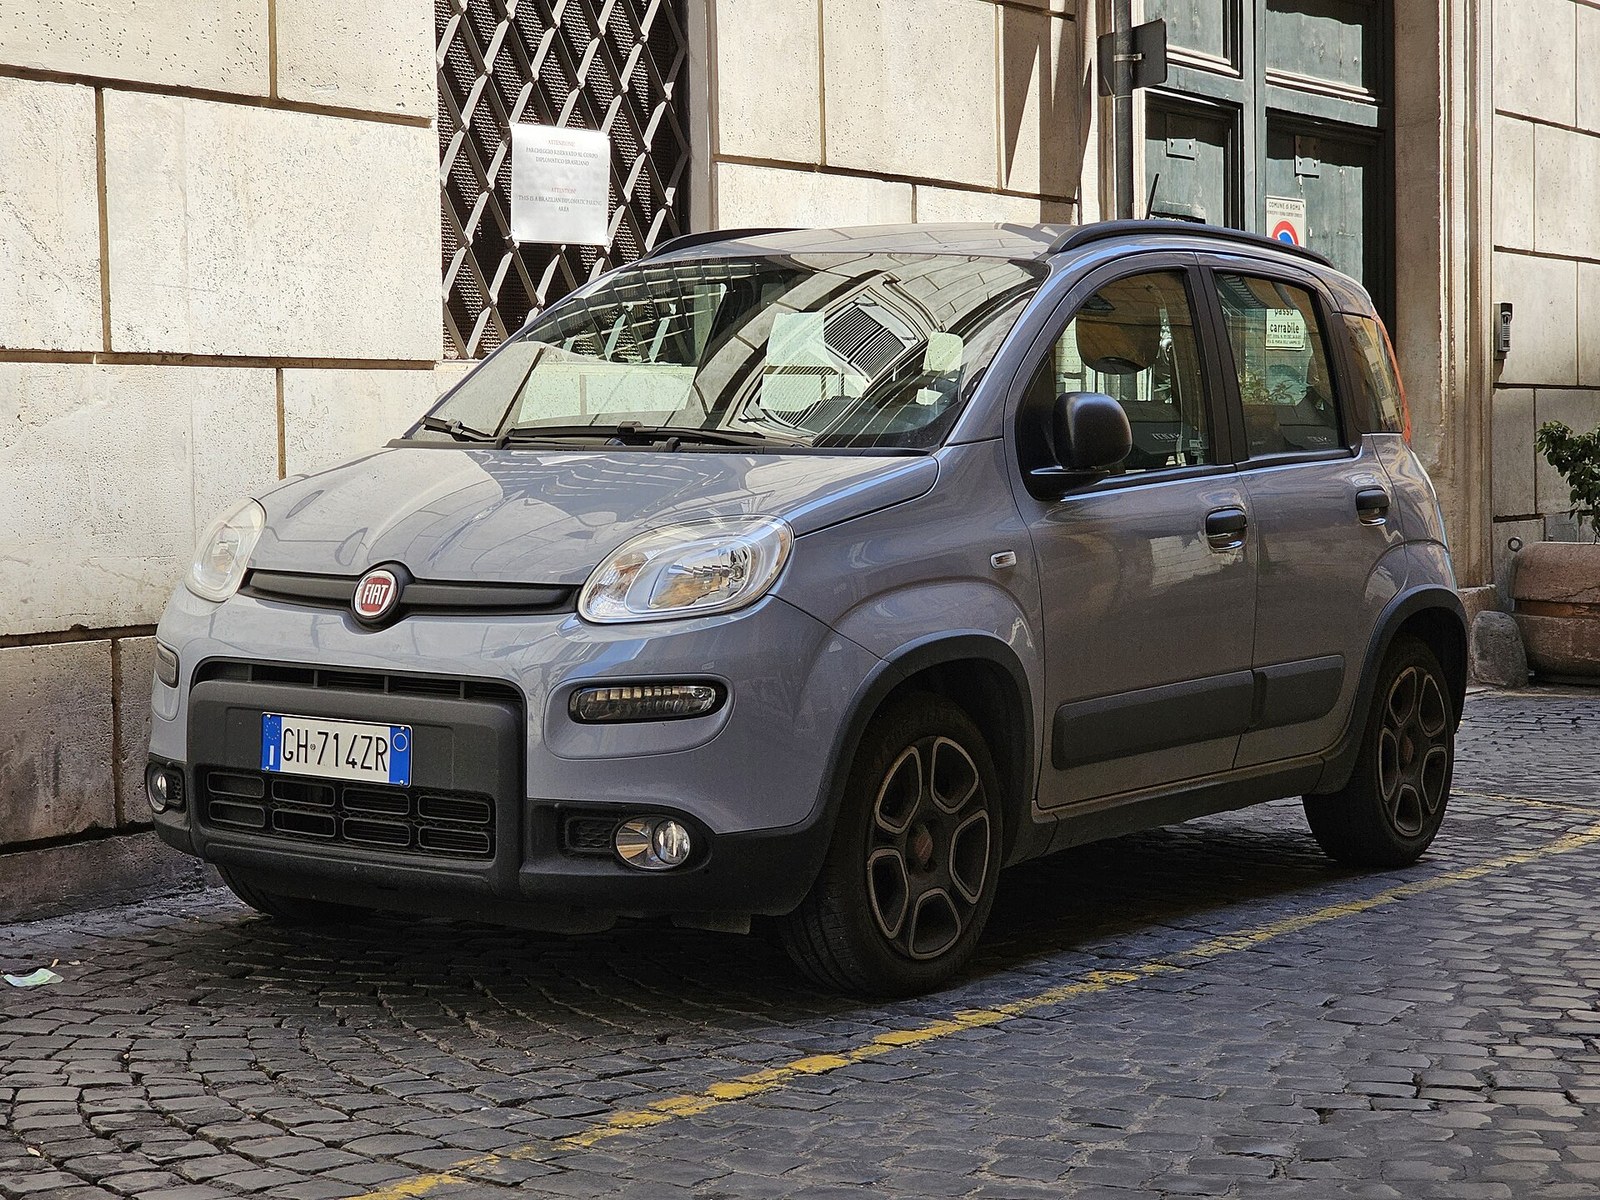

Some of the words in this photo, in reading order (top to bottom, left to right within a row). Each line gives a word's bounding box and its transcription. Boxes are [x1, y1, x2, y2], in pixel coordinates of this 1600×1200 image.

[535, 156, 564, 164] DIPLOMATICO
[561, 197, 586, 205] DIPLOMATIC
[1269, 201, 1285, 210] COMUNE
[1270, 321, 1300, 334] carrabile
[362, 583, 389, 605] FIAT
